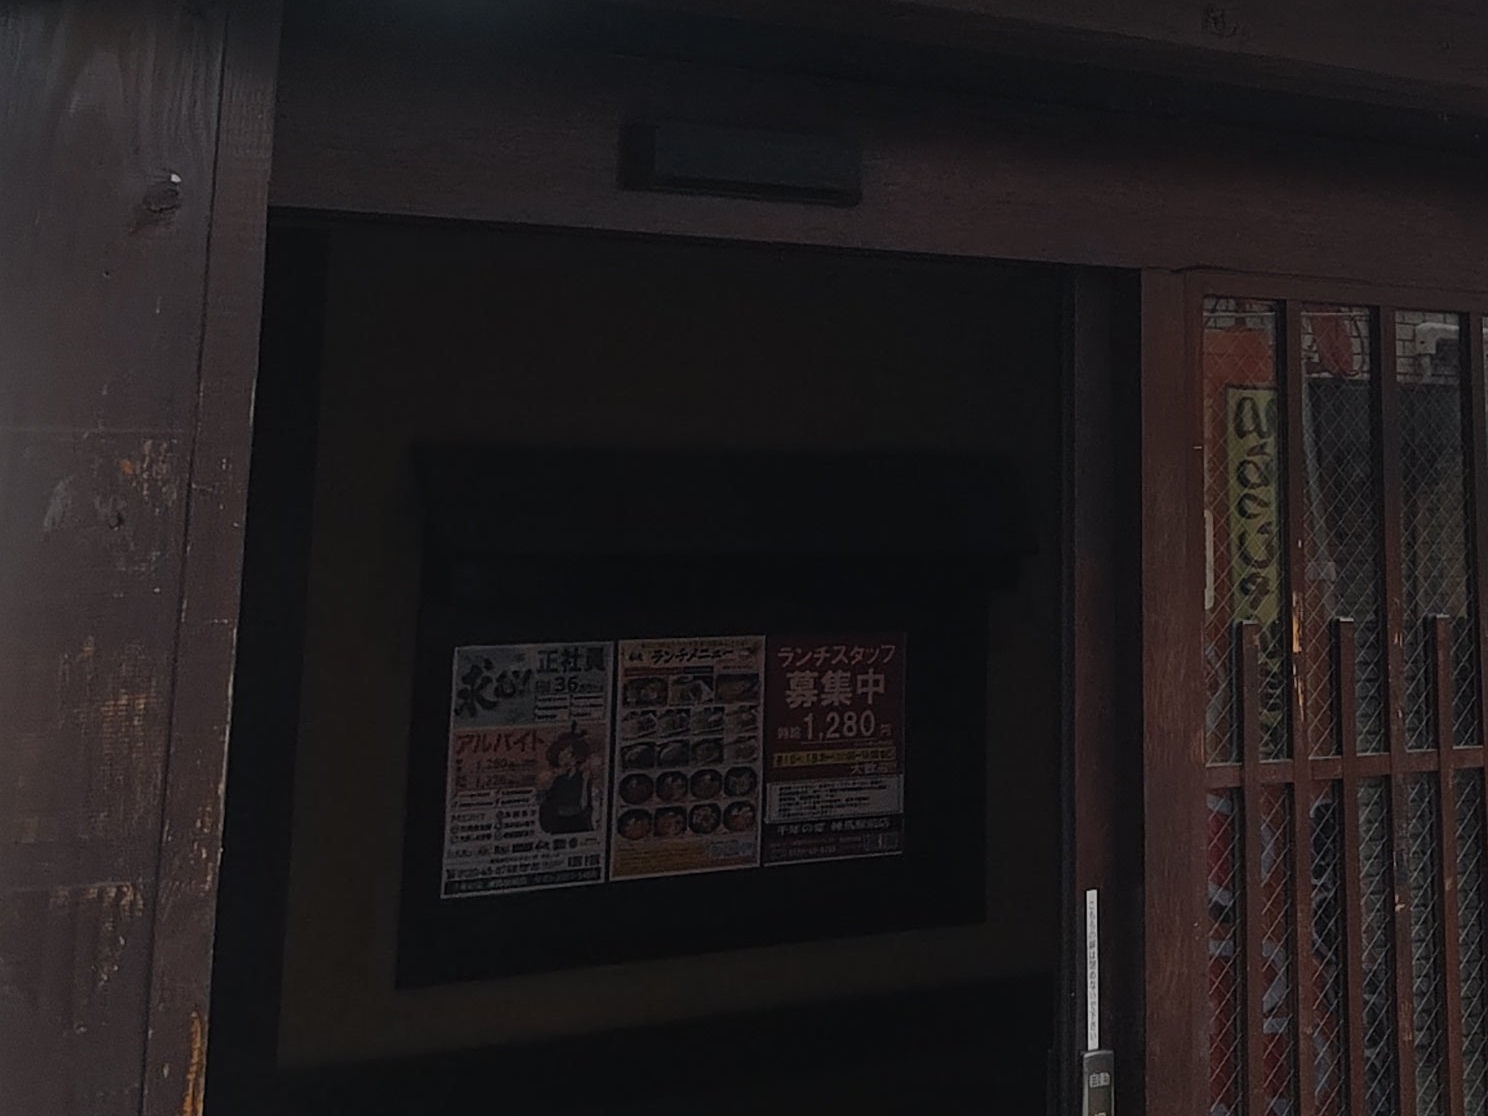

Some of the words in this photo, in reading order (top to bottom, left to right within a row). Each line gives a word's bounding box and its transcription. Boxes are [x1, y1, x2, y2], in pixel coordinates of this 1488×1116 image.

[652, 647, 734, 664] ランチメニュー
[777, 644, 896, 667] ランチスタッフ
[785, 668, 886, 708] 募集中
[455, 731, 545, 754] アルバイト
